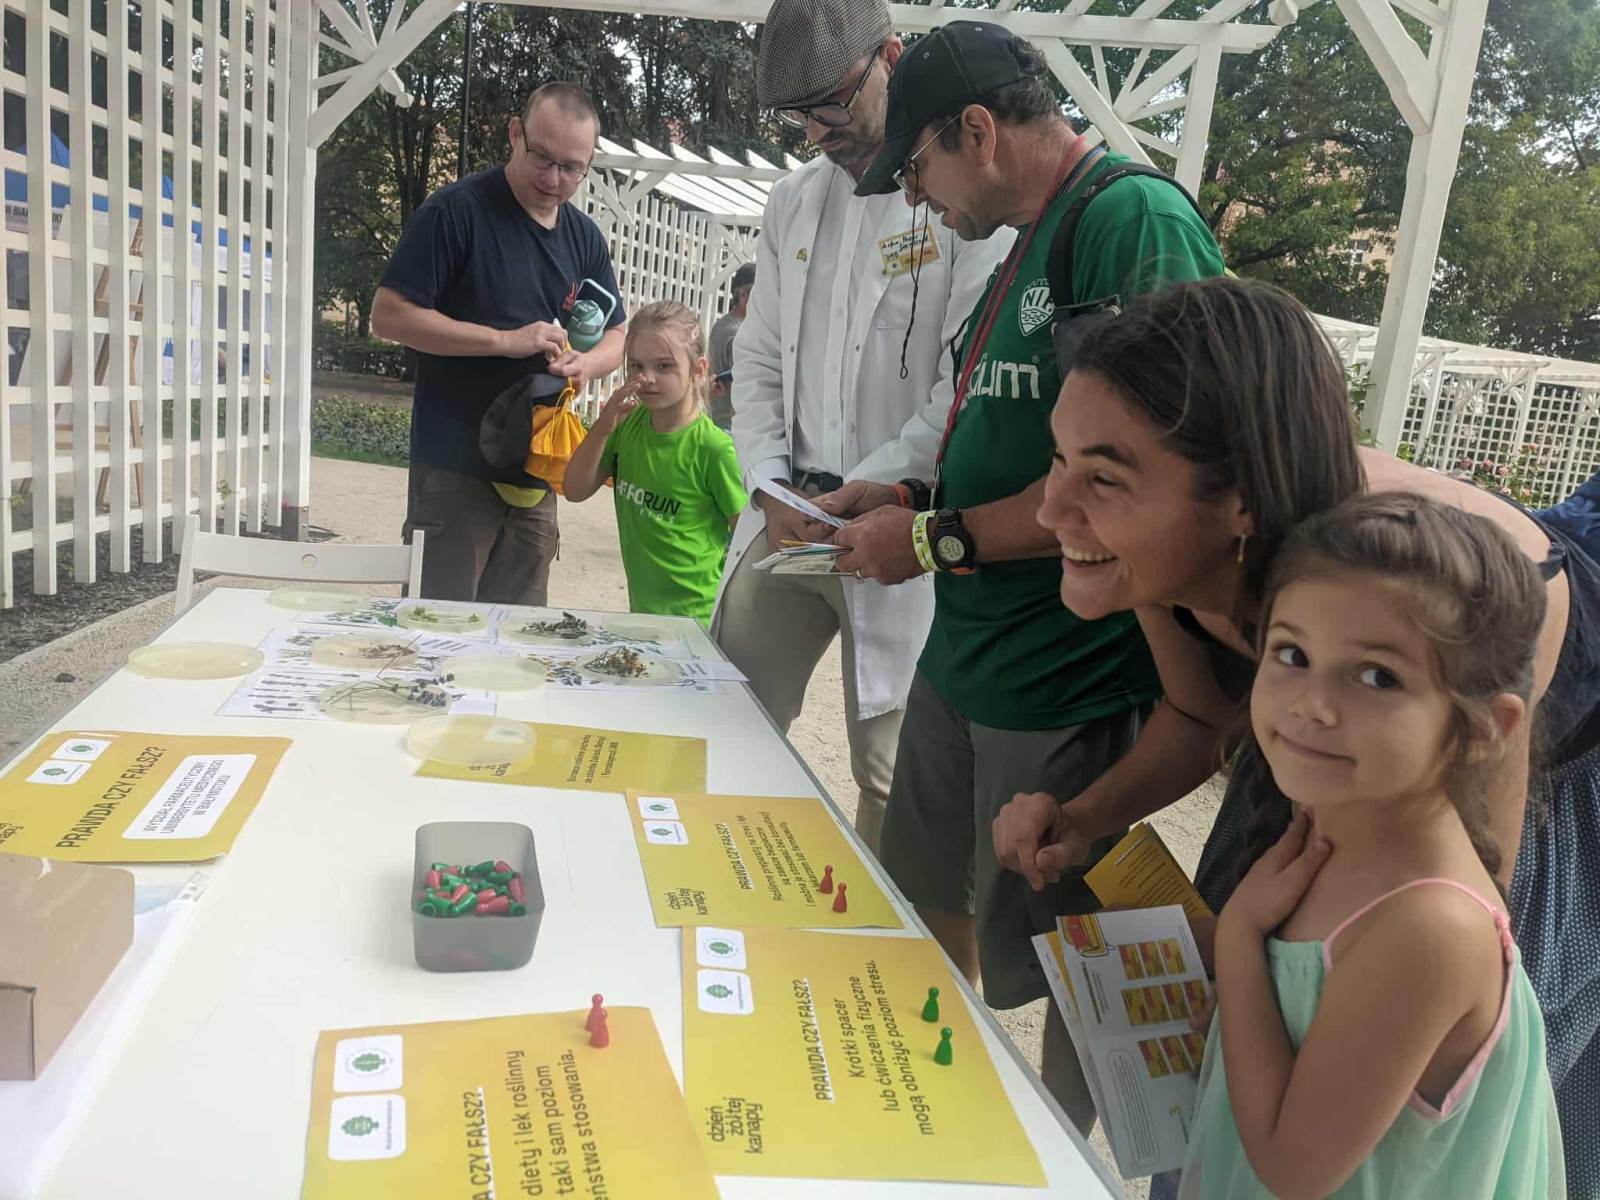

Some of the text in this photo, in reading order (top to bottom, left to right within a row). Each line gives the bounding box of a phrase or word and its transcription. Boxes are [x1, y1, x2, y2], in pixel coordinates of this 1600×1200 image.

[56, 802, 120, 848] PRAWDA
[102, 782, 136, 799] CZY
[121, 746, 166, 780] FAŁSZ?
[715, 823, 753, 890] PRAWDA CZY FAŁSZ?
[792, 979, 833, 1101] PRAWDA CZY FAŁSZ?
[834, 997, 865, 1078] Krótki spacer
[849, 975, 900, 1112] lub ćwiczenia fizyczne
[866, 959, 935, 1136] mogą obniżyć poziom stresu.
[504, 1050, 528, 1108] roślinny
[558, 1048, 593, 1138] stosowania.
[462, 1089, 489, 1149] FAŁSZ?
[511, 1111, 534, 1136] lek
[535, 1064, 575, 1196] taki sam poziom
[704, 1105, 726, 1142] dzień
[723, 1097, 746, 1137] żółtej
[745, 1102, 765, 1154] kanapy
[467, 1152, 492, 1186] CZY
[519, 1147, 544, 1197] diety
